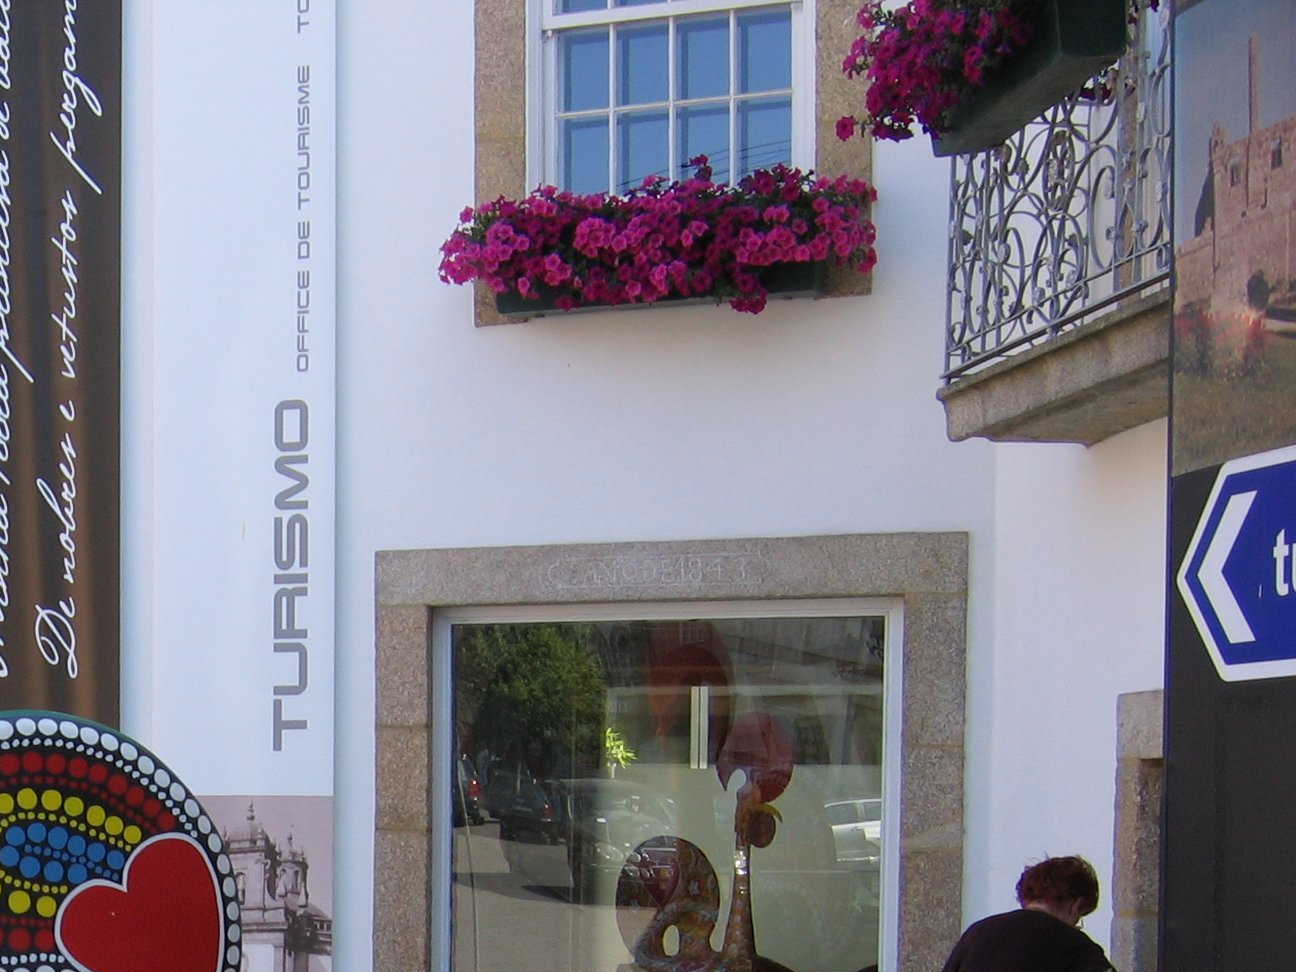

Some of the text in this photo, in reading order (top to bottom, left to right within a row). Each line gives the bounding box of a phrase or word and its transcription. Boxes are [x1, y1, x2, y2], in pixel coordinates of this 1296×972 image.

[51, 190, 78, 378] vetustos
[297, 64, 310, 372] OFFICE DE TOURISME
[59, 399, 75, 421] e
[36, 432, 76, 584] nobres
[272, 399, 309, 751] TURISMO
[34, 596, 77, 678] De
